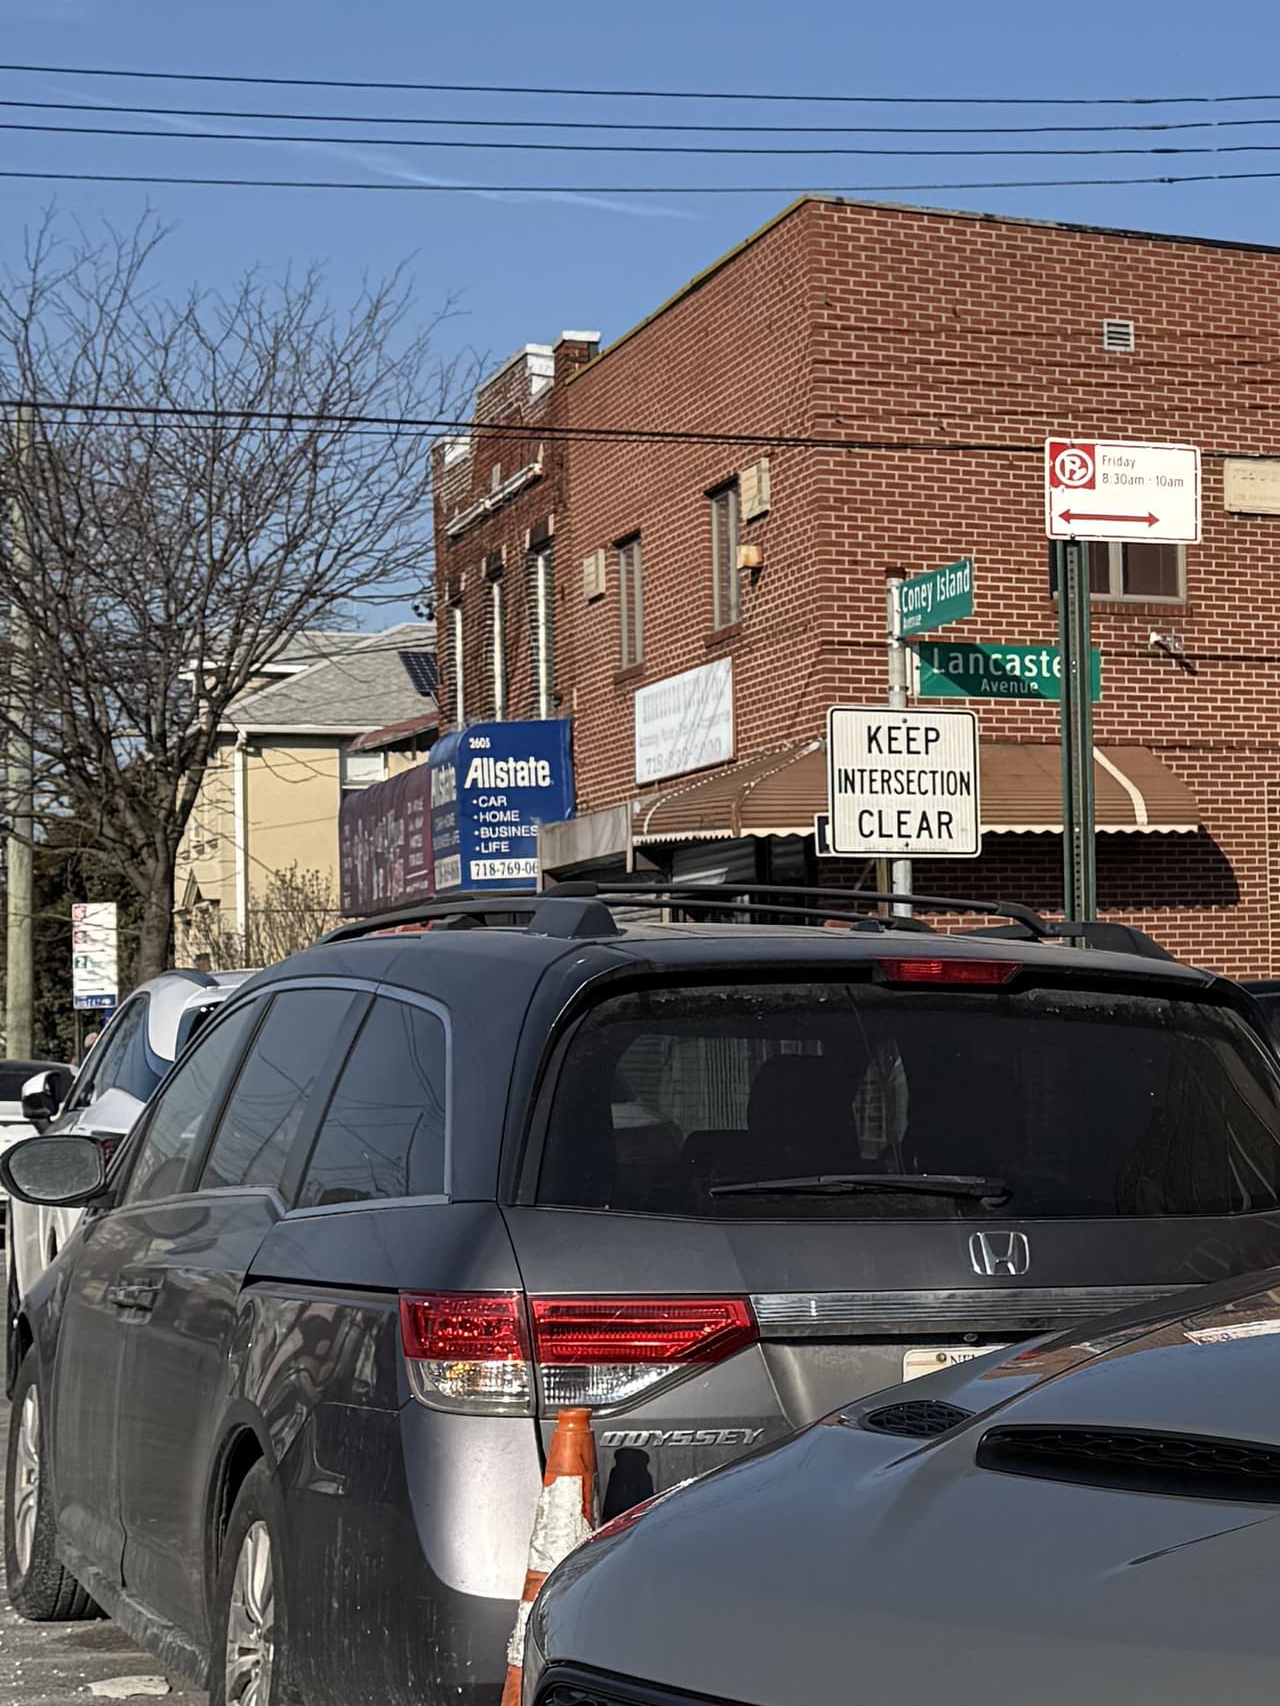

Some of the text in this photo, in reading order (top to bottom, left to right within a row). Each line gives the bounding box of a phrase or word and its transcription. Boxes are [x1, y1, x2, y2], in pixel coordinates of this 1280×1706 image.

[1101, 454, 1137, 470] Friday
[1101, 473, 1145, 487] 8:30am
[1156, 475, 1185, 488] 10am
[902, 560, 970, 614] Coney Island
[932, 647, 1062, 679] Lancaste
[980, 679, 1040, 695] Avenue
[867, 725, 941, 756] KEEP
[464, 756, 551, 790] Allstate
[837, 767, 971, 797] INTERSECTION
[478, 796, 508, 808] CAR
[479, 810, 521, 823] HOME
[857, 808, 954, 840] CLEAR
[480, 825, 539, 838] BUSINES
[480, 841, 511, 853] LIFE
[474, 861, 538, 877] 718-769-06
[599, 1428, 767, 1448] ODYSSEY
